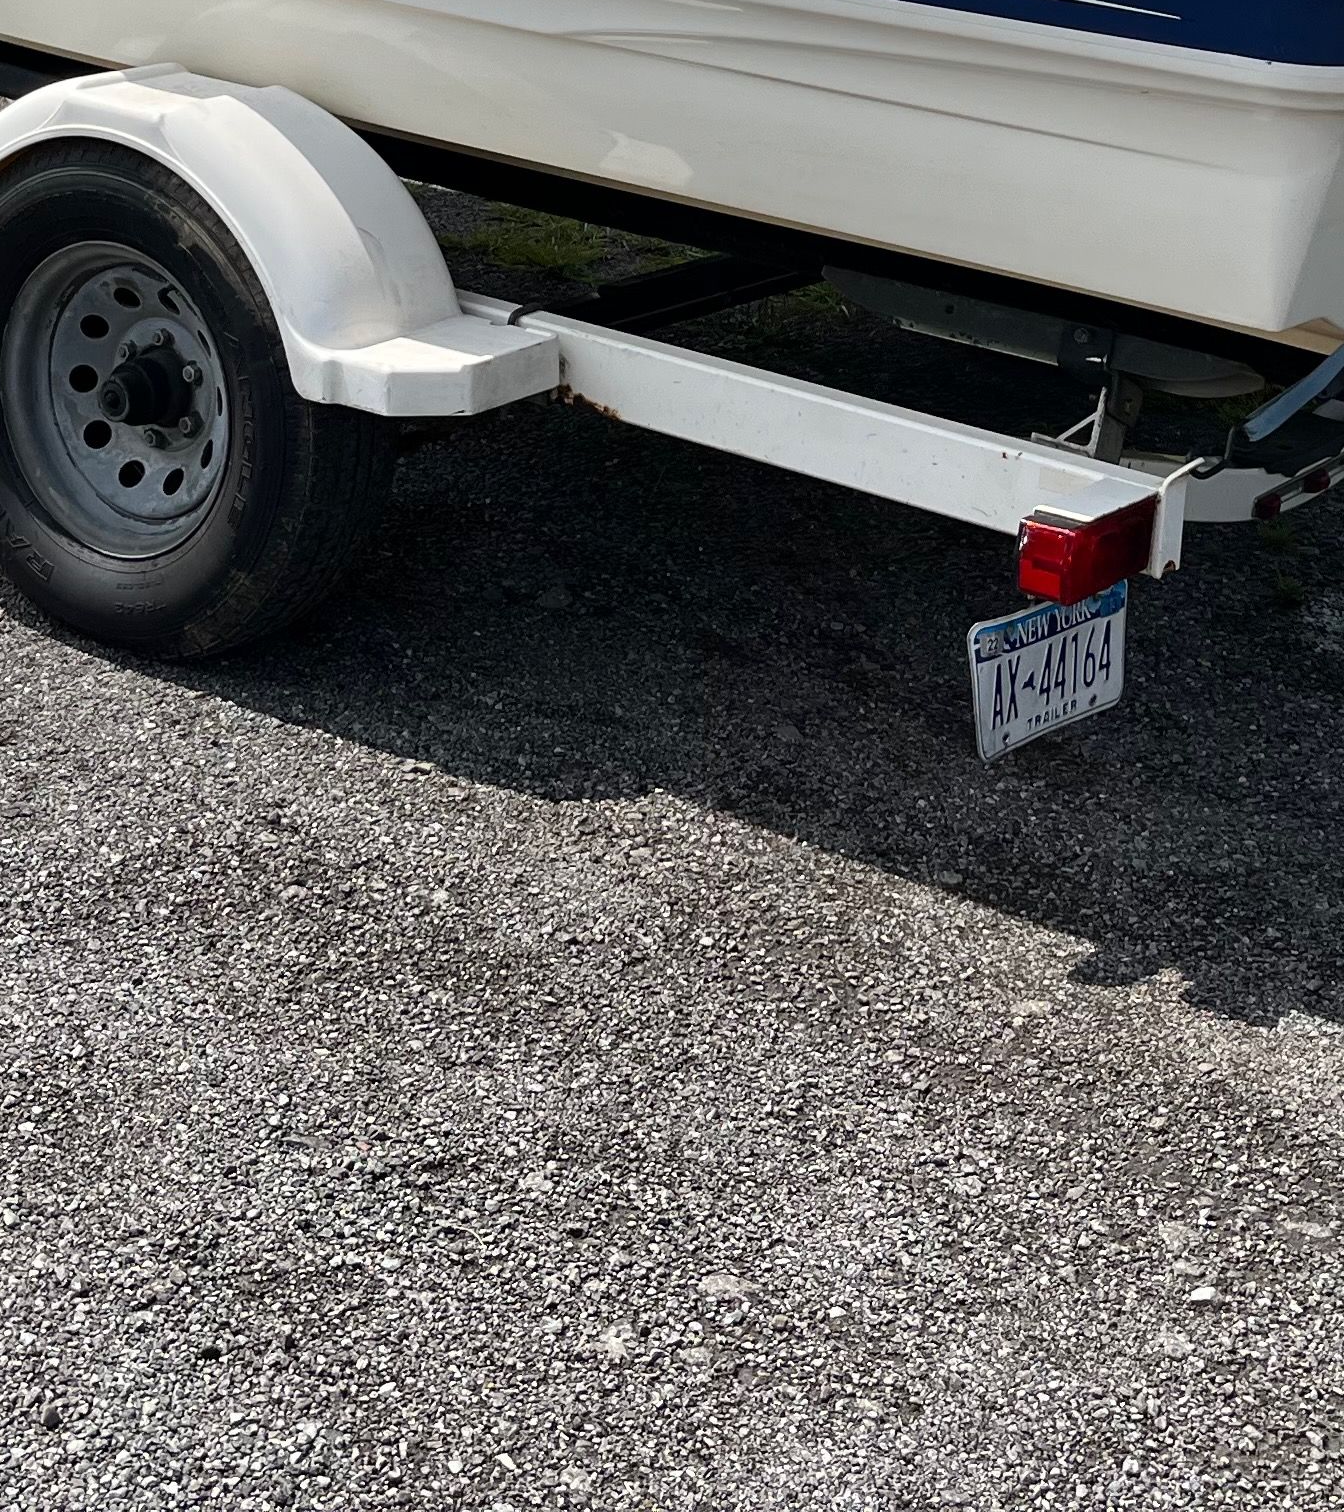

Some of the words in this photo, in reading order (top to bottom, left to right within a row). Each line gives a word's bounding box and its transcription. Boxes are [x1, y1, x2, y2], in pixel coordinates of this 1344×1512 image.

[1016, 611, 1051, 647] NEW
[1053, 600, 1091, 631] YORK
[987, 637, 999, 652] 22
[991, 654, 1020, 731] AX
[1038, 619, 1112, 706] 44164
[1026, 699, 1077, 730] TRAILER
